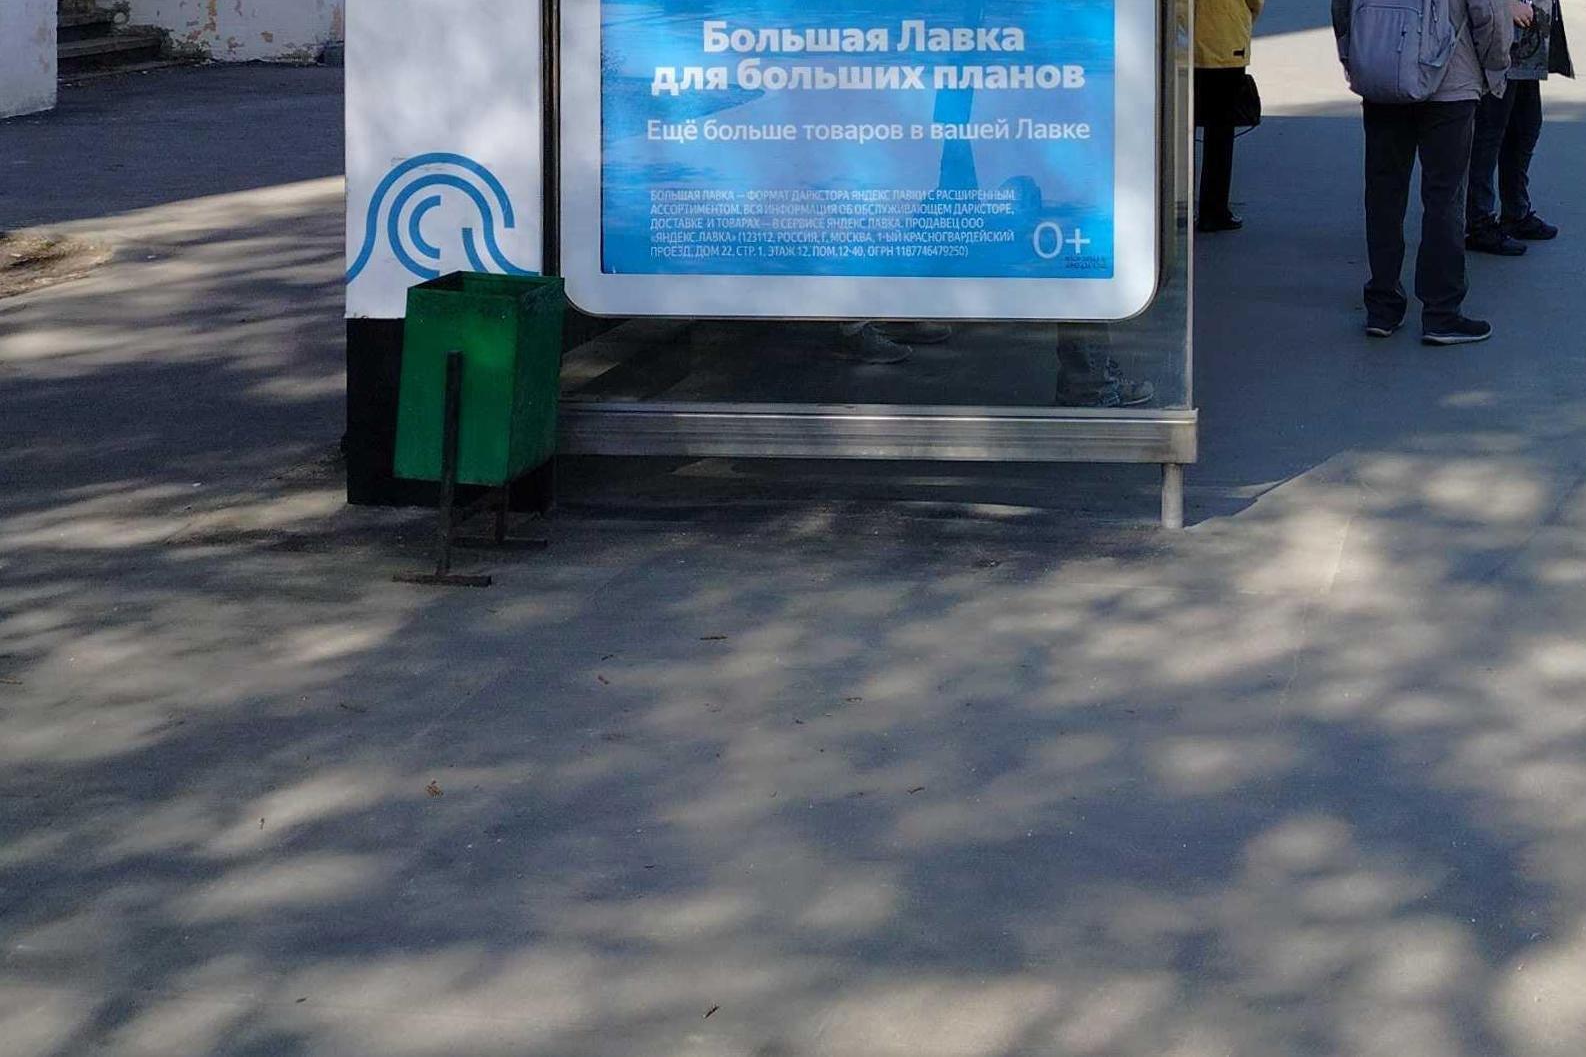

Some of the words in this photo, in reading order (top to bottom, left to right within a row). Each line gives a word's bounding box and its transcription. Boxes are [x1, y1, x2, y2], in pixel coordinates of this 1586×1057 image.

[704, 20, 888, 53] Большая
[897, 20, 1024, 53] Лавка
[652, 64, 727, 96] для
[737, 58, 924, 90] больших
[934, 64, 1085, 90] планов
[648, 119, 698, 146] Ещё
[704, 119, 796, 140] больше
[804, 123, 904, 145] товаров
[911, 124, 924, 139] в
[931, 118, 1010, 139] вашей
[1014, 119, 1091, 139] Лавке
[1033, 222, 1091, 259] 0+
